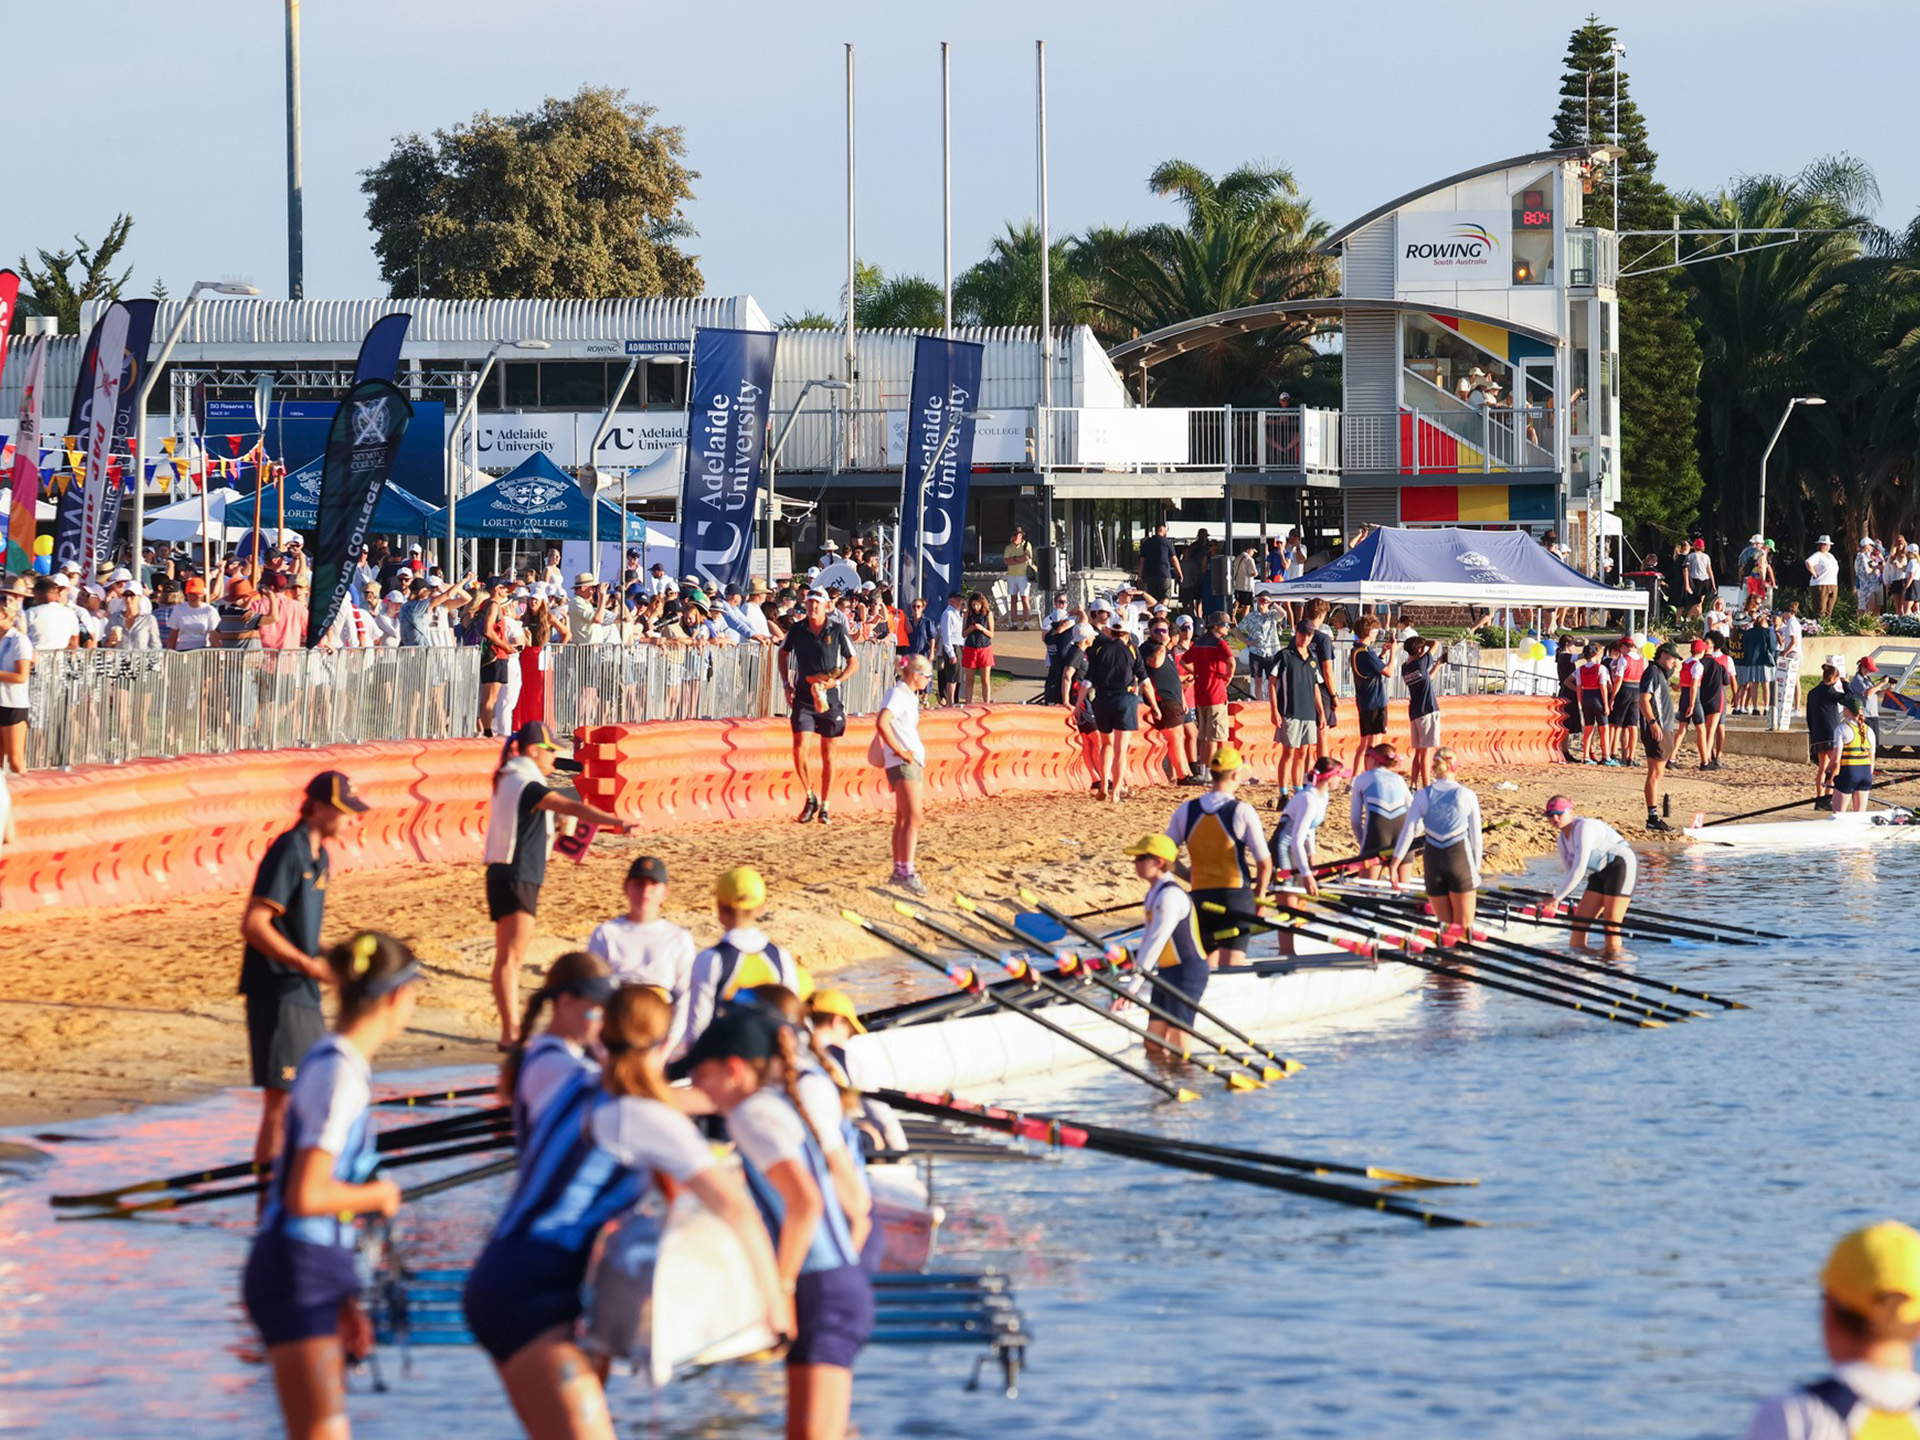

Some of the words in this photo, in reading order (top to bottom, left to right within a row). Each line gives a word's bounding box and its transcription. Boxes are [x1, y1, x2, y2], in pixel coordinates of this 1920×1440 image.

[1523, 211, 1551, 225] 8:04
[1406, 243, 1482, 258] ROWING
[587, 345, 618, 353] ROWING
[628, 342, 690, 352] ADMINISTRATION
[497, 428, 548, 440] Adelaide
[978, 428, 1020, 436] COLLEGE
[497, 440, 555, 453] University
[726, 378, 763, 512] University
[921, 395, 943, 498] Adelaide
[938, 384, 969, 500] University
[700, 393, 730, 511] Adelaide
[347, 480, 381, 558] COLLEGE
[482, 518, 521, 527] LORETO
[523, 518, 569, 528] COLLEGE
